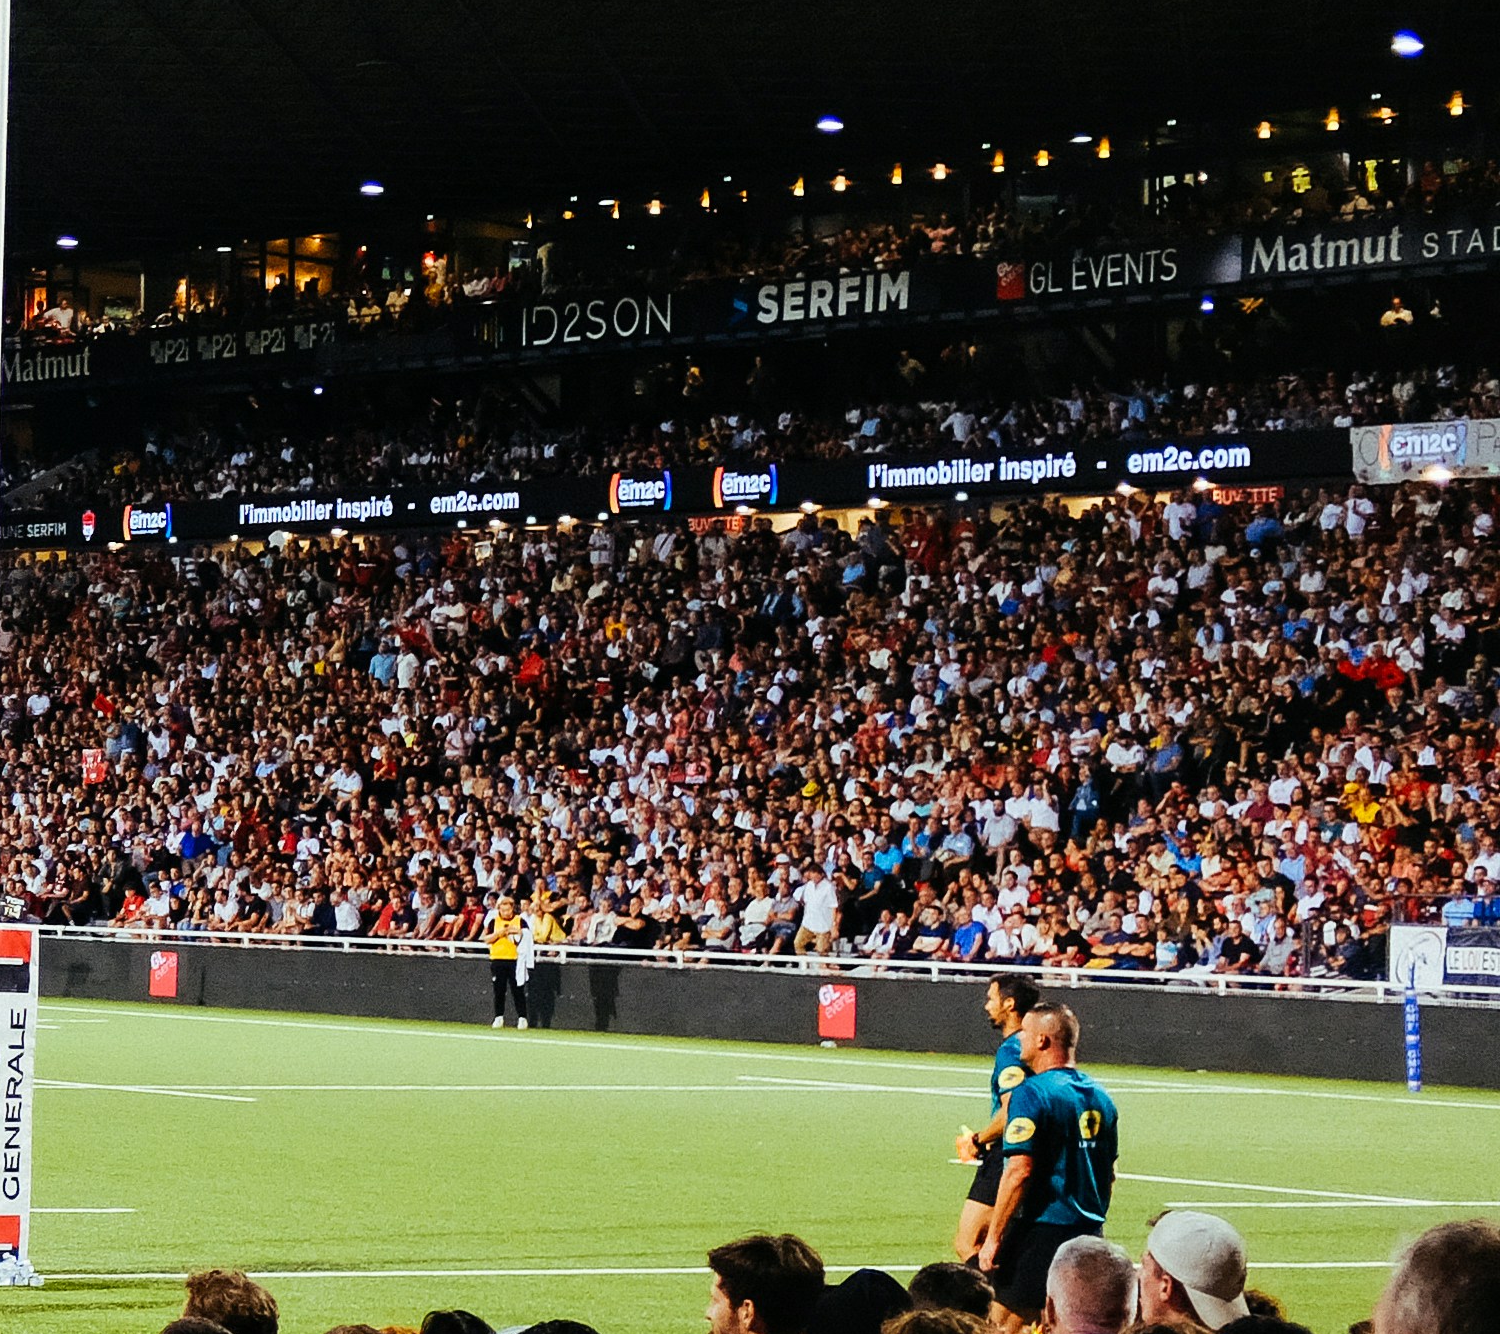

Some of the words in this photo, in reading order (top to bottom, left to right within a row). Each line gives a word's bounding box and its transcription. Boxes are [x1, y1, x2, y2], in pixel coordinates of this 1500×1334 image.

[1250, 225, 1404, 273] Matmut
[1030, 262, 1063, 294] GL
[1072, 249, 1177, 291] EVENTS
[757, 271, 911, 324] SERFIM
[2, 347, 91, 383] Matmut
[722, 473, 771, 495] em2c
[868, 458, 995, 489] l'immobilier
[1000, 451, 1076, 484] inspiré
[1128, 445, 1251, 474] em2c.com
[239, 499, 334, 525] l'immobilier
[336, 495, 393, 523] inspiré
[430, 490, 520, 514] em2c.com
[618, 480, 665, 501] em2c
[27, 522, 67, 537] SERFIM
[130, 511, 167, 529] em2c
[2, 1007, 28, 1201] GENERALE
